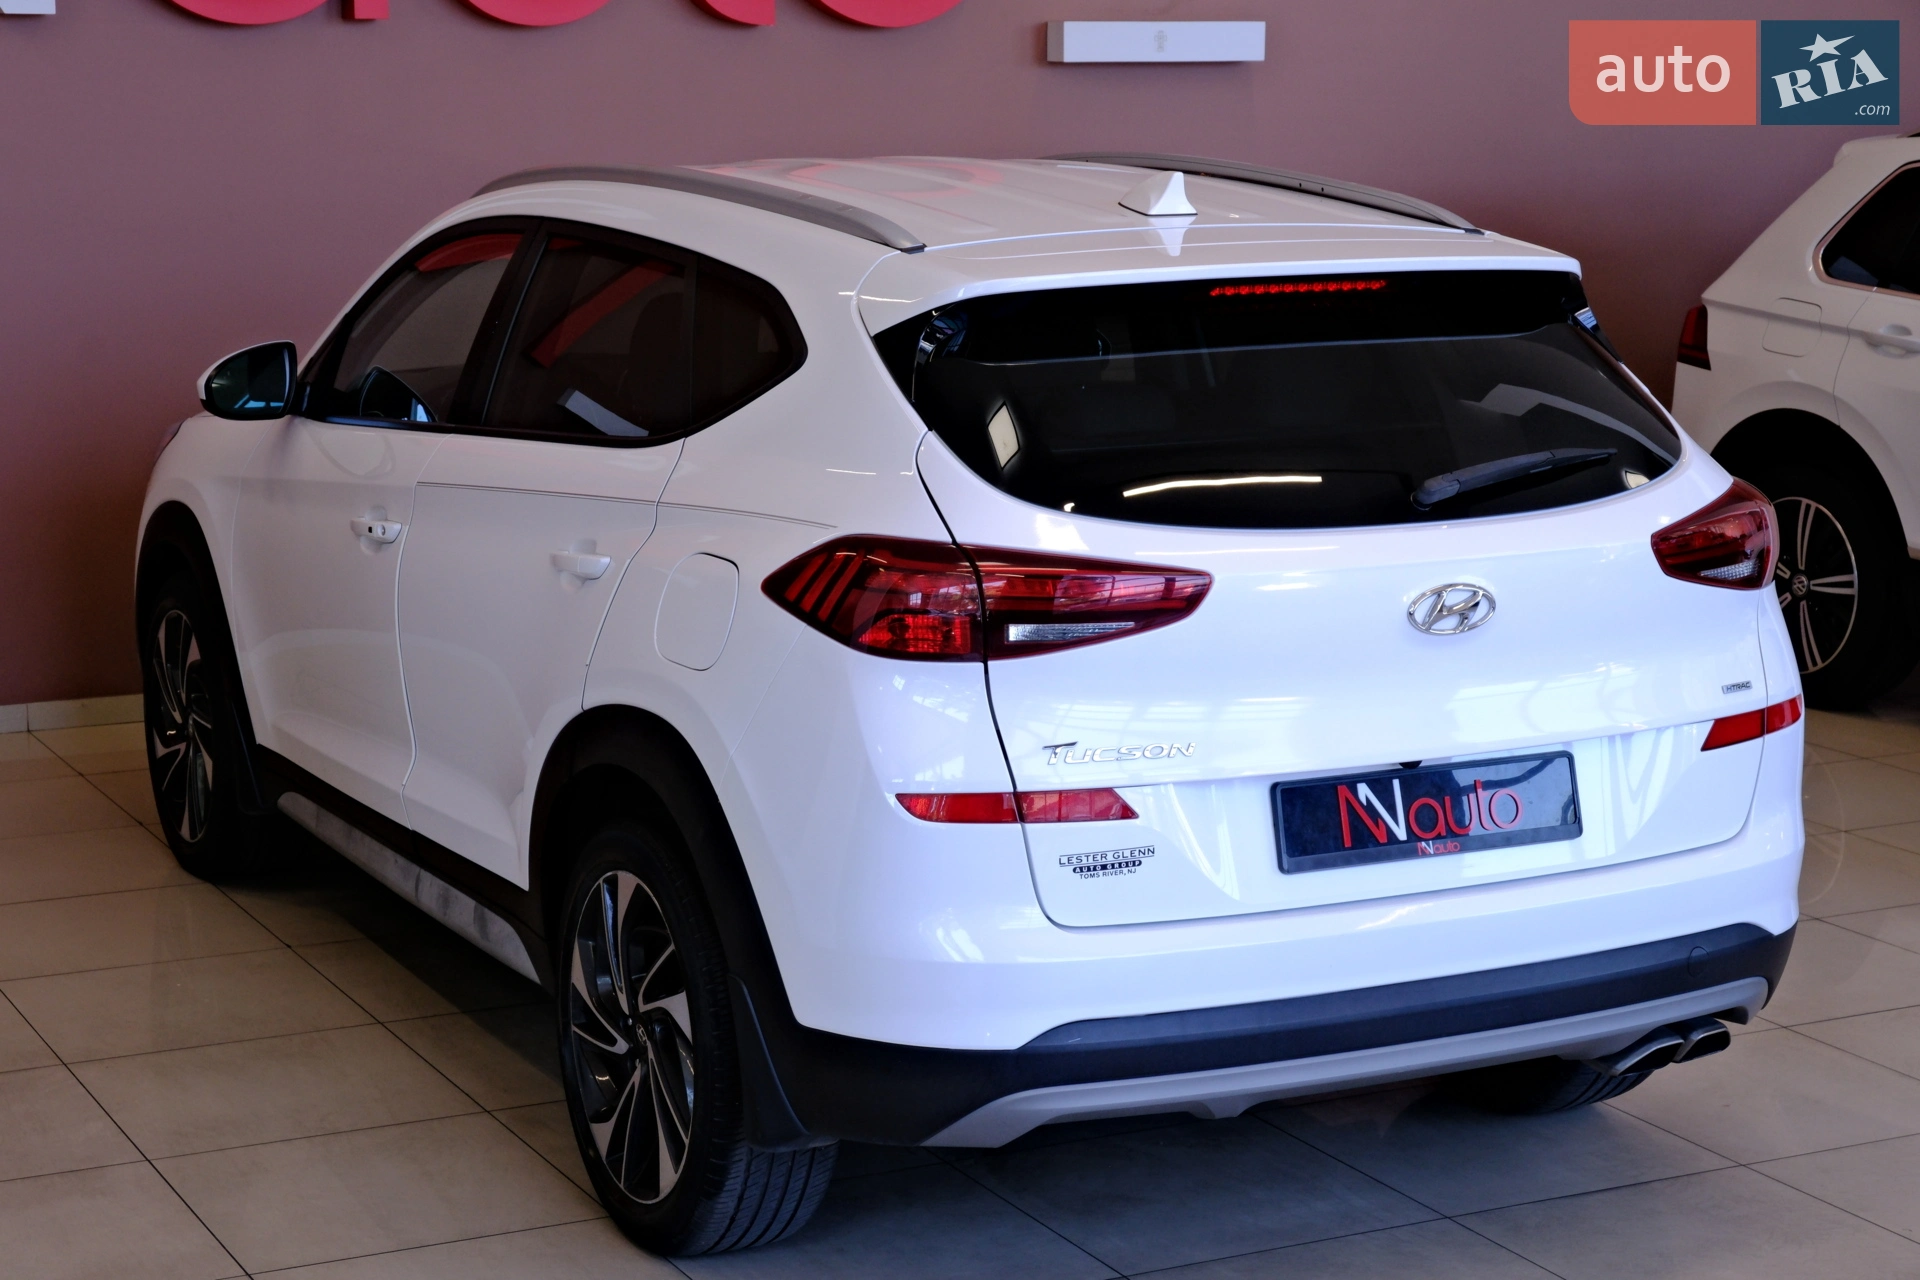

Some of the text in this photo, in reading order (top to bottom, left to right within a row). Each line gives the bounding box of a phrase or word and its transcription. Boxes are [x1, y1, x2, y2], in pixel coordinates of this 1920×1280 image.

[1726, 681, 1751, 692] HTRAC
[1058, 847, 1155, 865] LESTER GLENN
[1074, 860, 1141, 873] AUTO GROUP
[1079, 872, 1101, 880] TOMS
[1102, 869, 1127, 877] RIVER,
